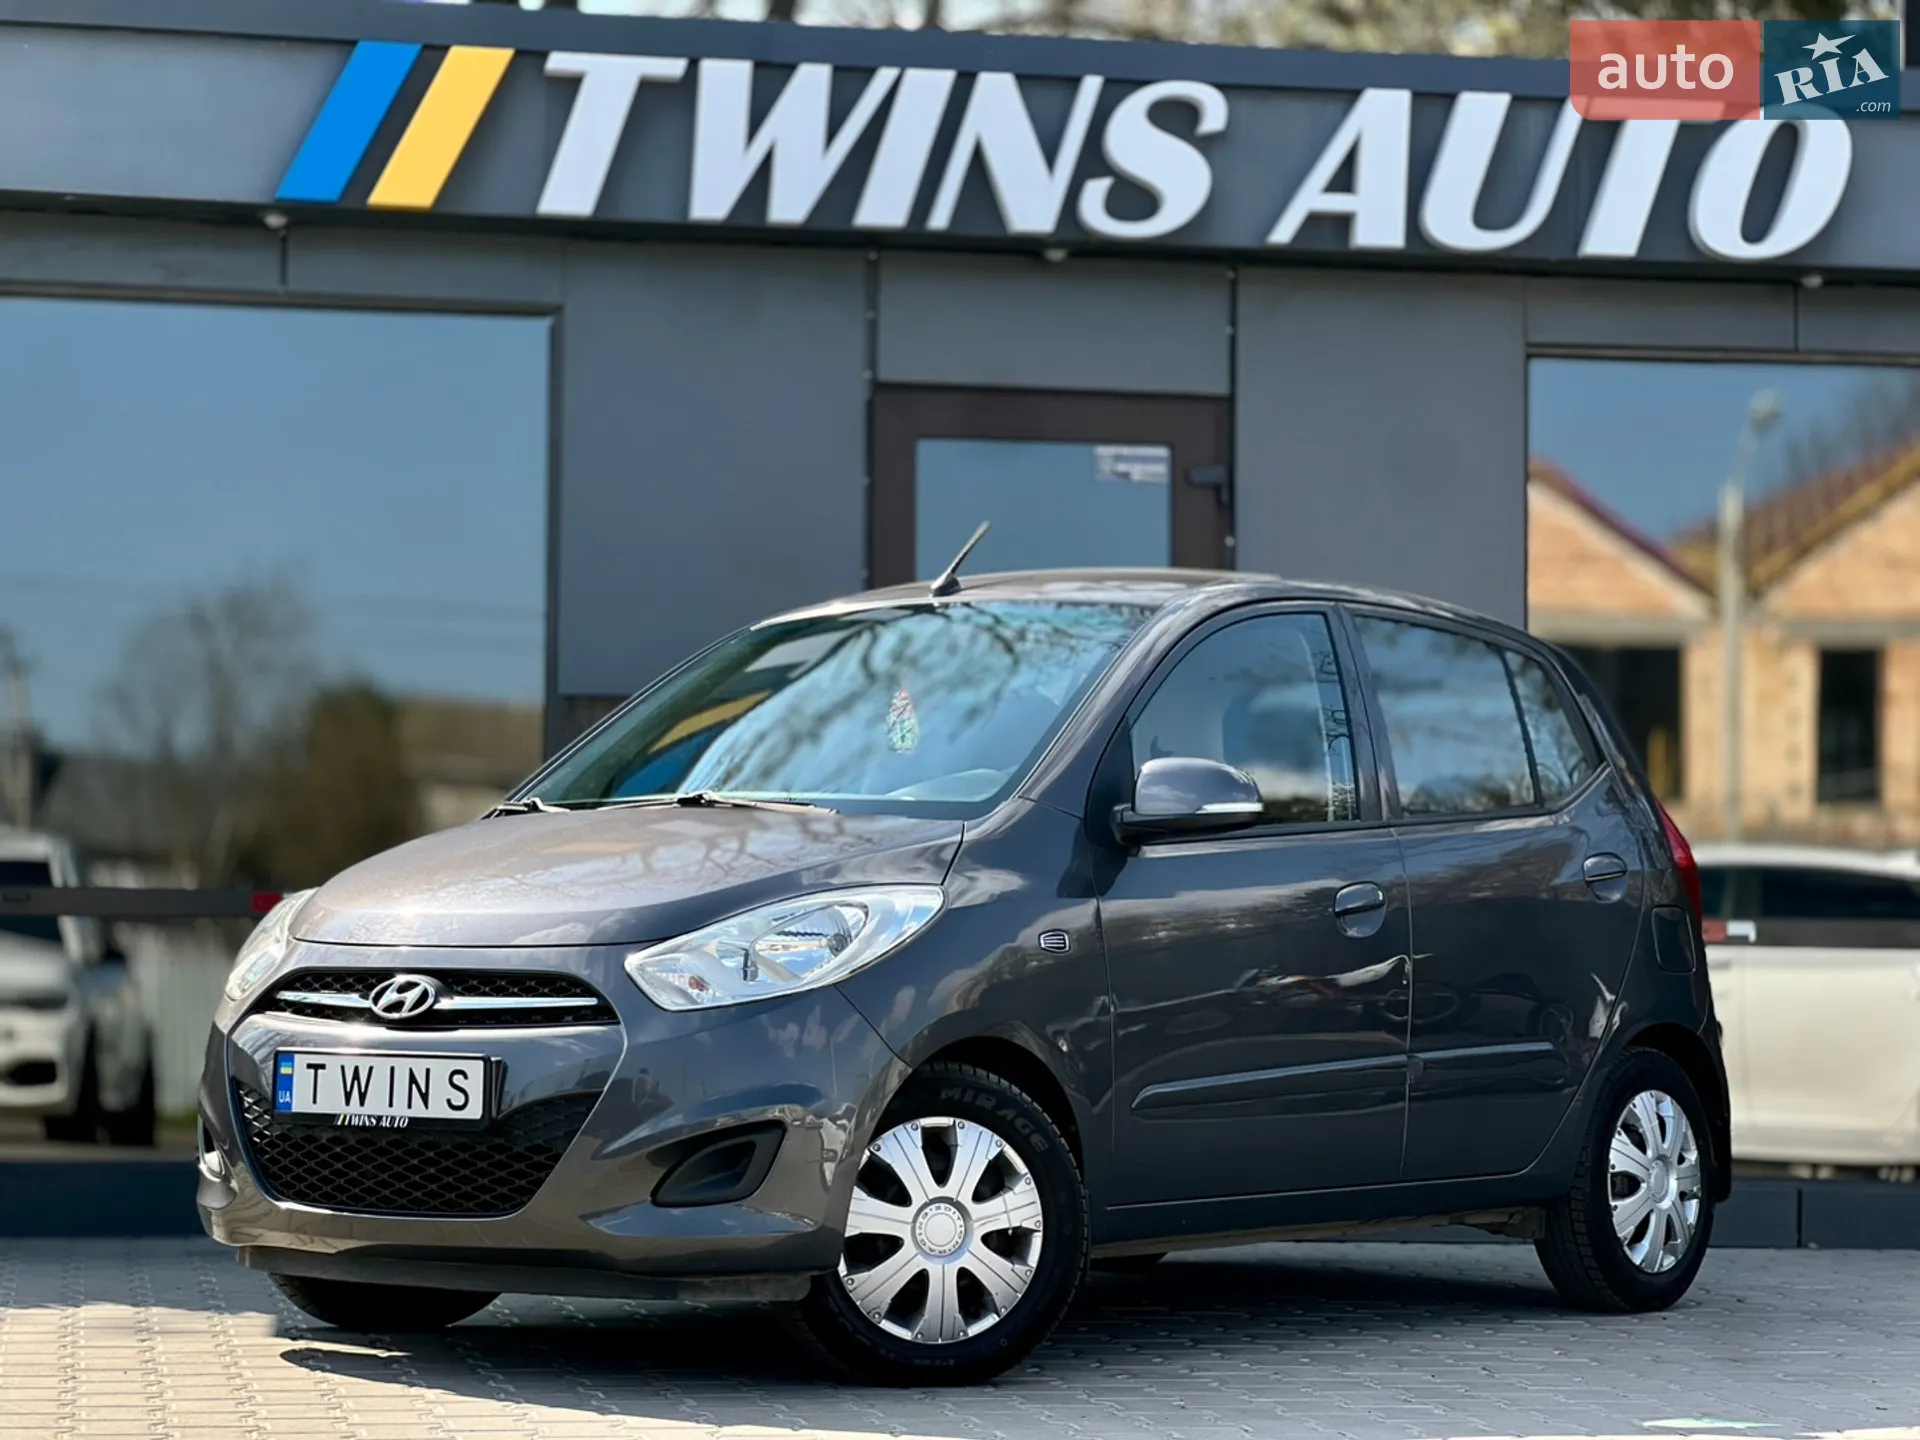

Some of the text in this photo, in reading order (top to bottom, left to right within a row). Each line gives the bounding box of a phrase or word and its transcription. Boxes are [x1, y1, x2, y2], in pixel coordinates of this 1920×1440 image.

[536, 50, 1853, 260] TWINS AUTO
[278, 1090, 292, 1103] UA
[305, 1062, 470, 1112] TWINS
[344, 1113, 409, 1129] TWINS AUTO
[941, 1086, 1050, 1154] MIRAGE
